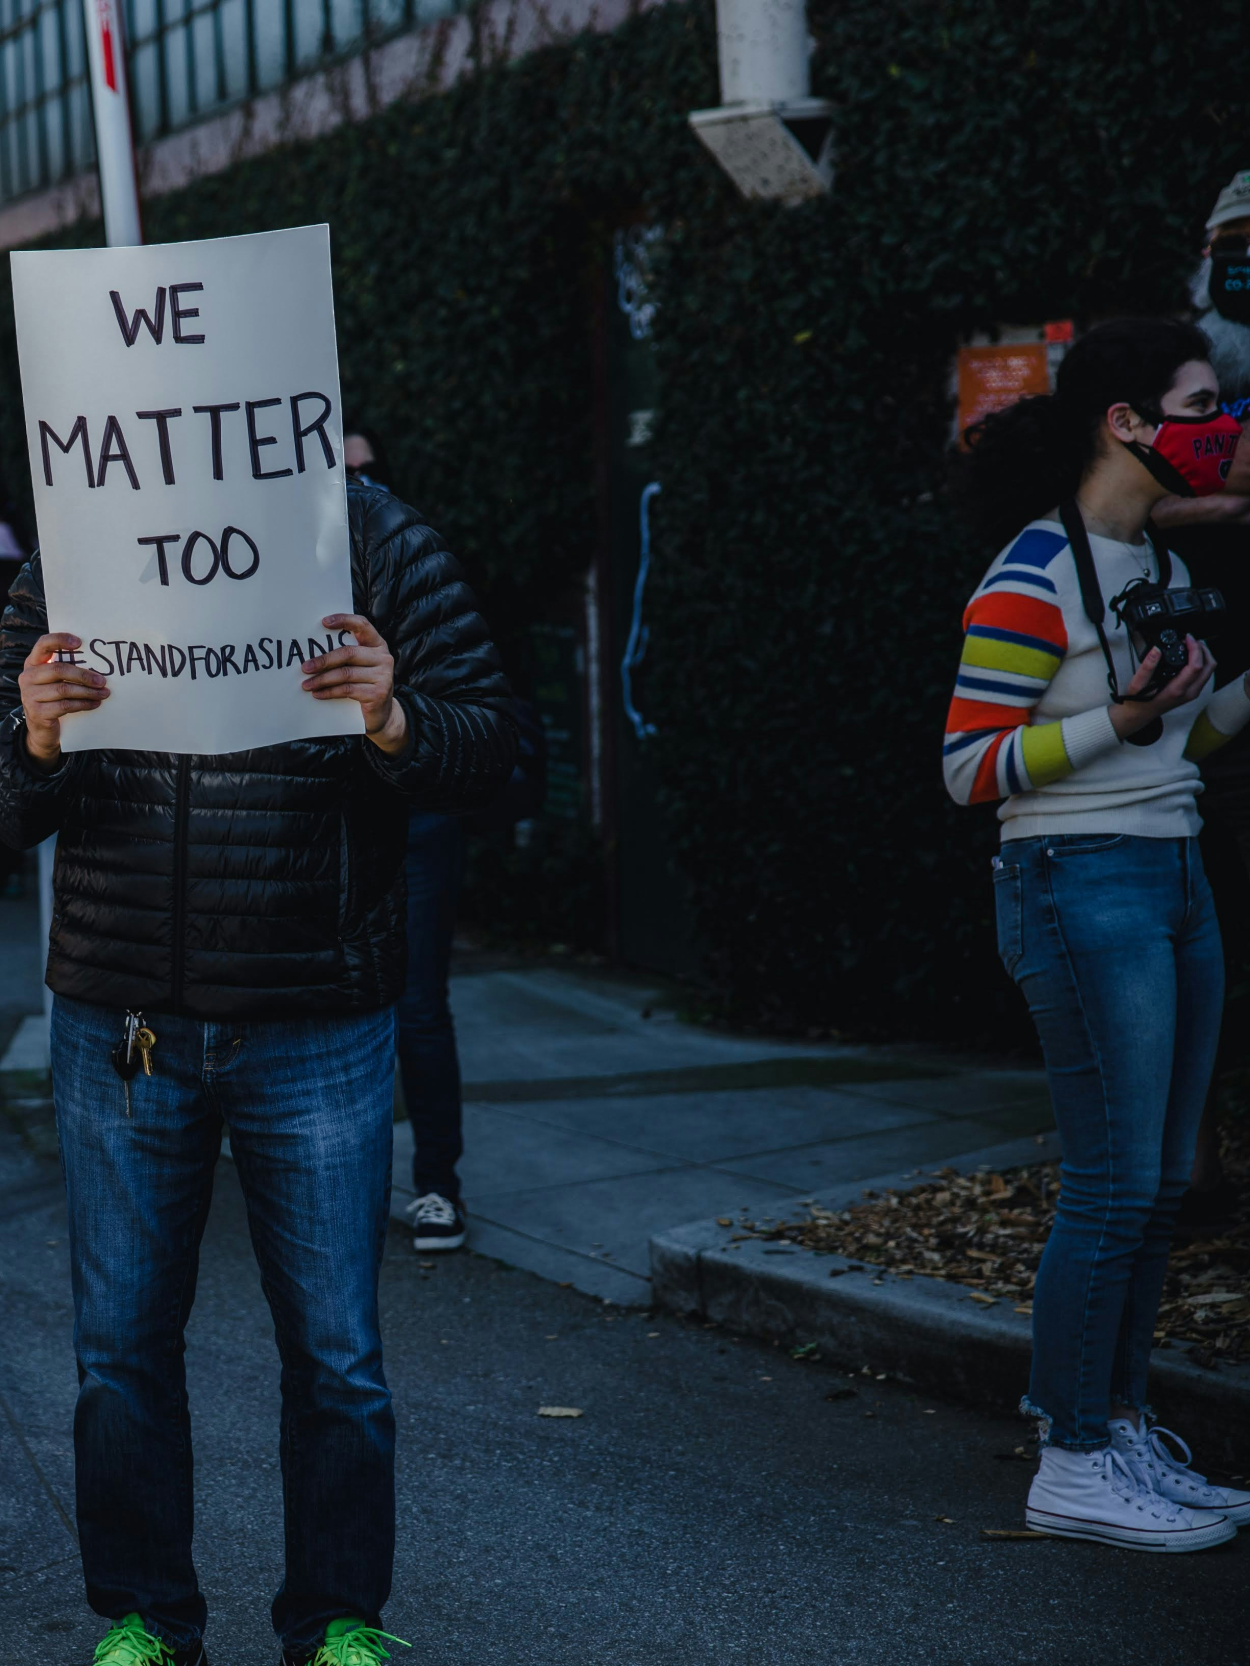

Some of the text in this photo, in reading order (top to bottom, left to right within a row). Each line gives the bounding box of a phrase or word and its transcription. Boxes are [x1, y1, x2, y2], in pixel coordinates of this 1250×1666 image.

[109, 282, 206, 347] WE
[38, 390, 337, 490] MATTER
[137, 525, 260, 587] TOO
